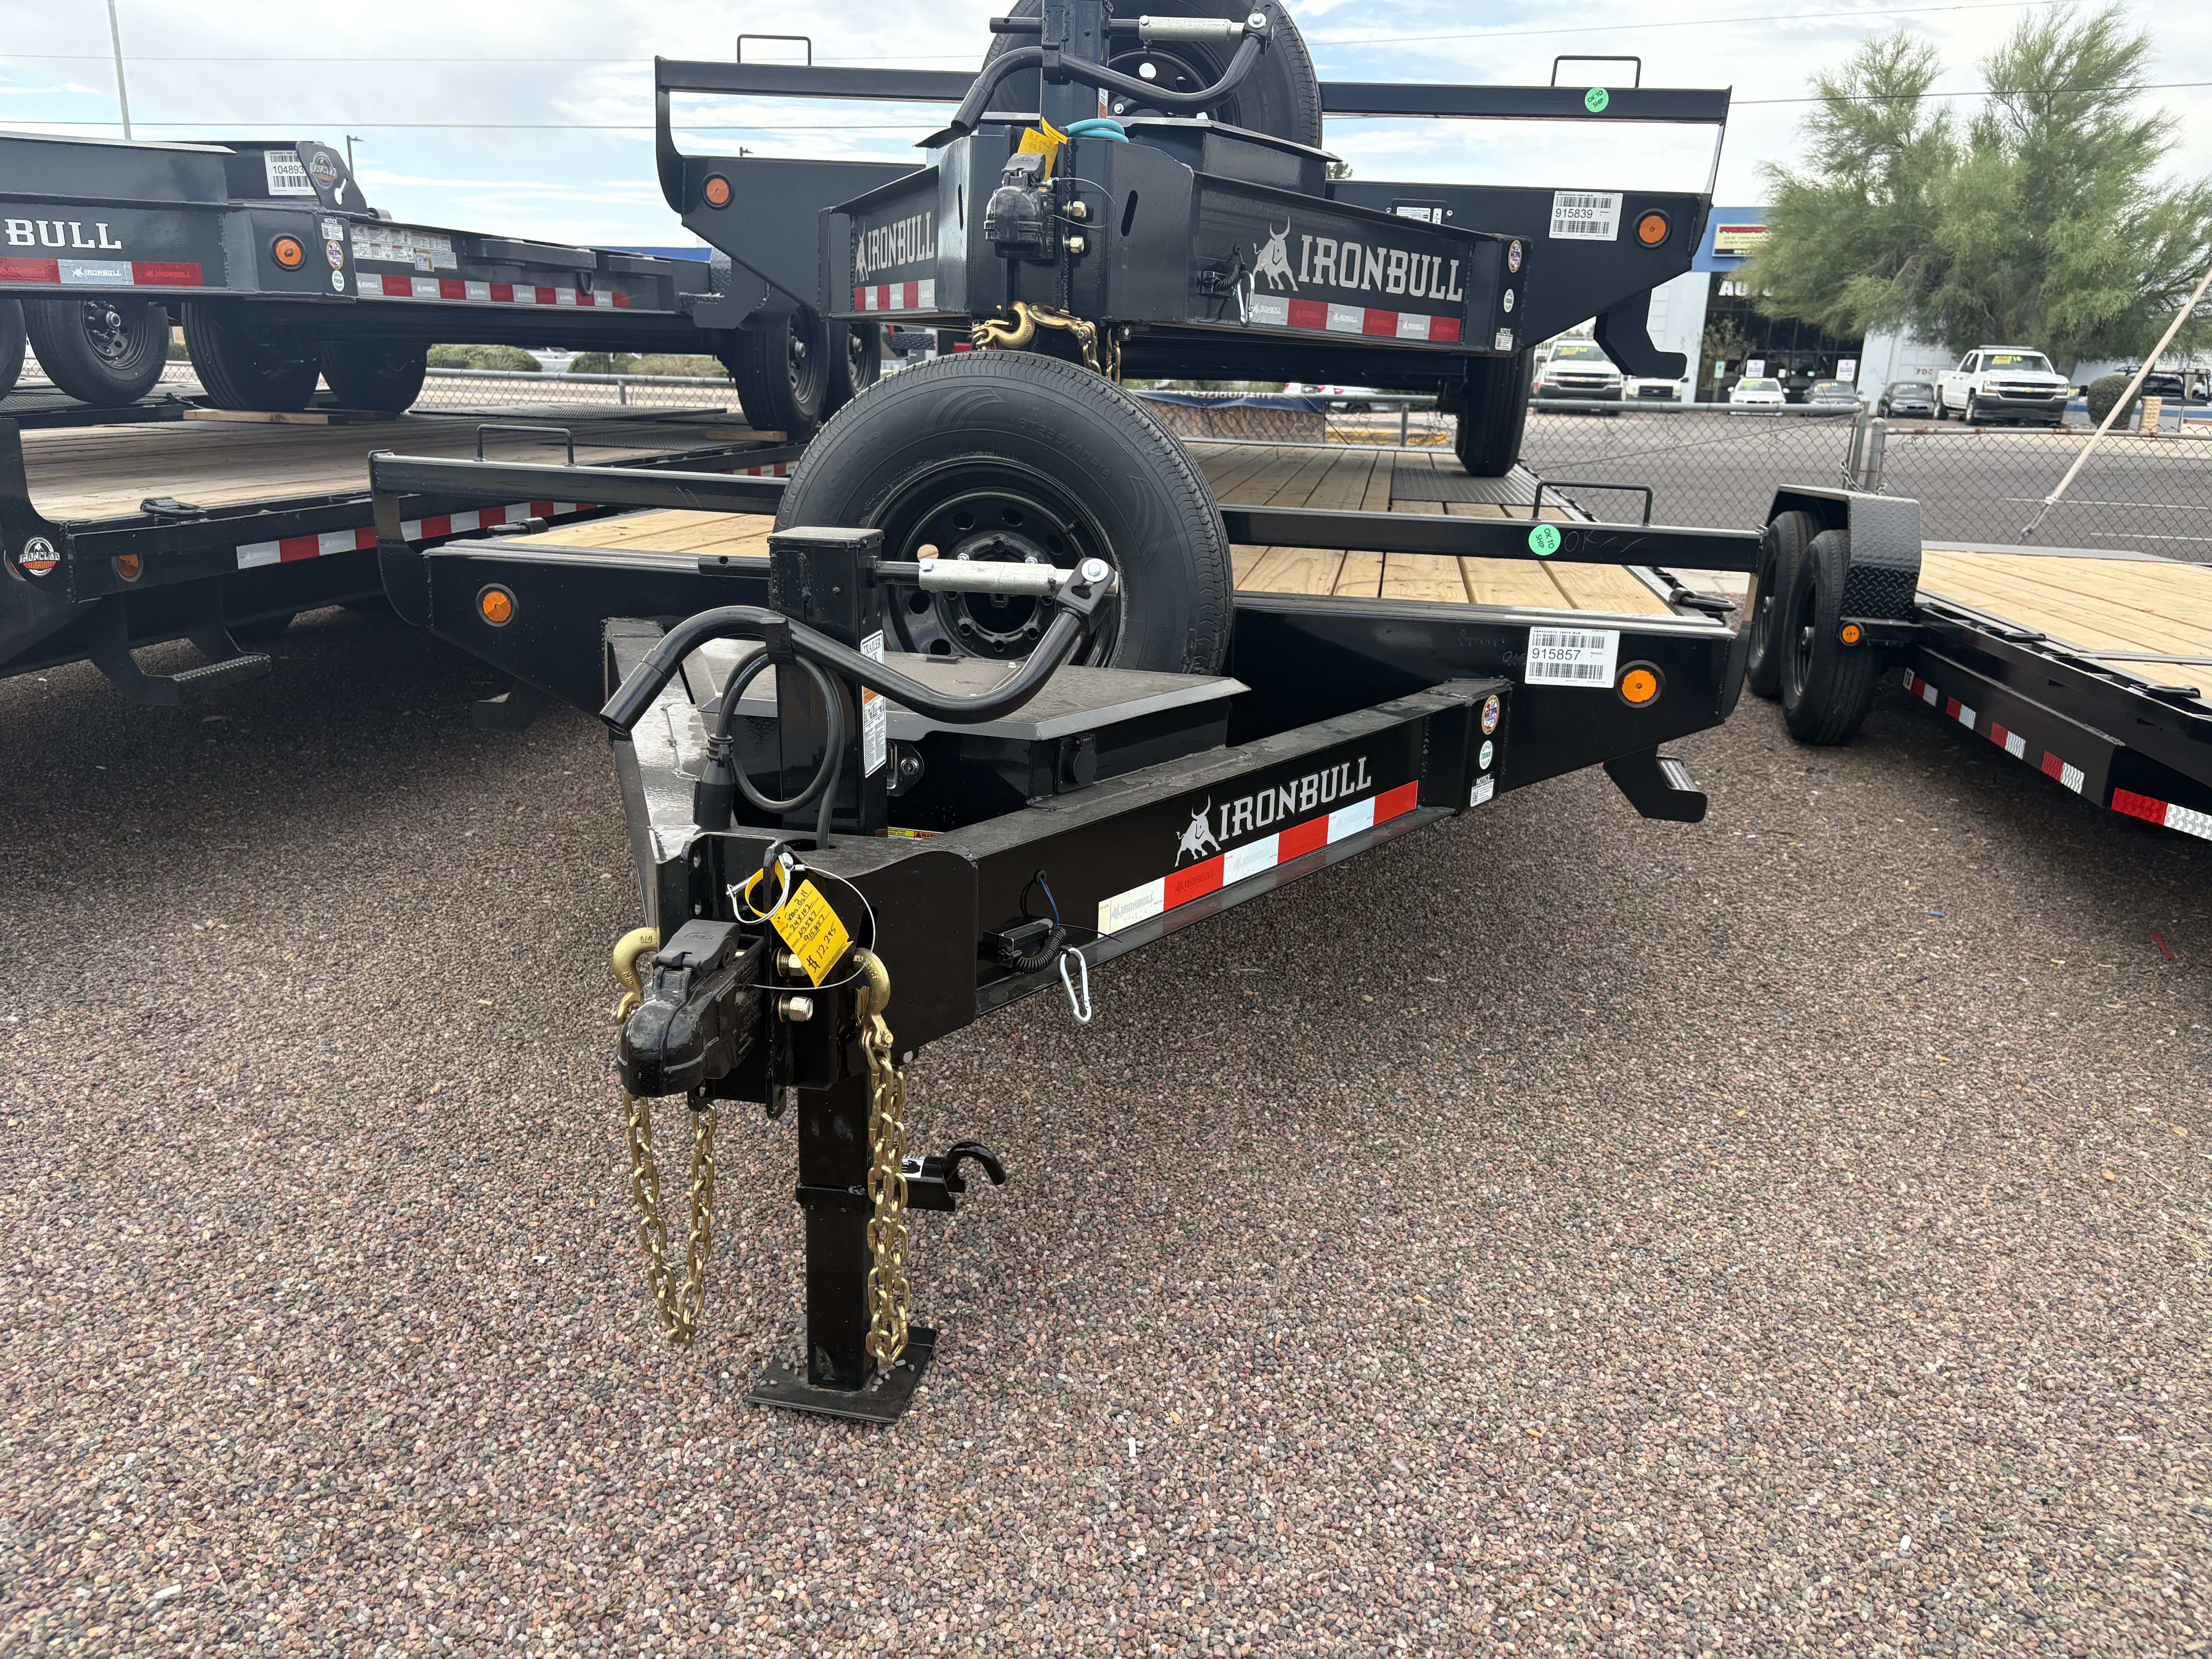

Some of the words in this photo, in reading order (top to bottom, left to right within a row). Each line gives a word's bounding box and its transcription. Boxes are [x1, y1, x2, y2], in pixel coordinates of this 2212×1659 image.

[1593, 98, 1603, 107] SHIP
[273, 165, 304, 174] 104893
[1555, 208, 1593, 218] 915839
[868, 211, 934, 272] IRONBULL
[1298, 234, 1463, 302] IRONBULL
[1544, 528, 1552, 539] OK
[1536, 534, 1545, 548] SHIP
[1547, 539, 1554, 549] TO
[19, 551, 60, 563] IRONCLAD
[863, 638, 881, 656] TRAILER
[1532, 648, 1581, 660] 915857
[1476, 773, 1491, 785] NOTICE
[1219, 757, 1372, 842] IRONBULL
[1184, 870, 1215, 888] IRONBULL
[1120, 894, 1154, 914] IRONBULL
